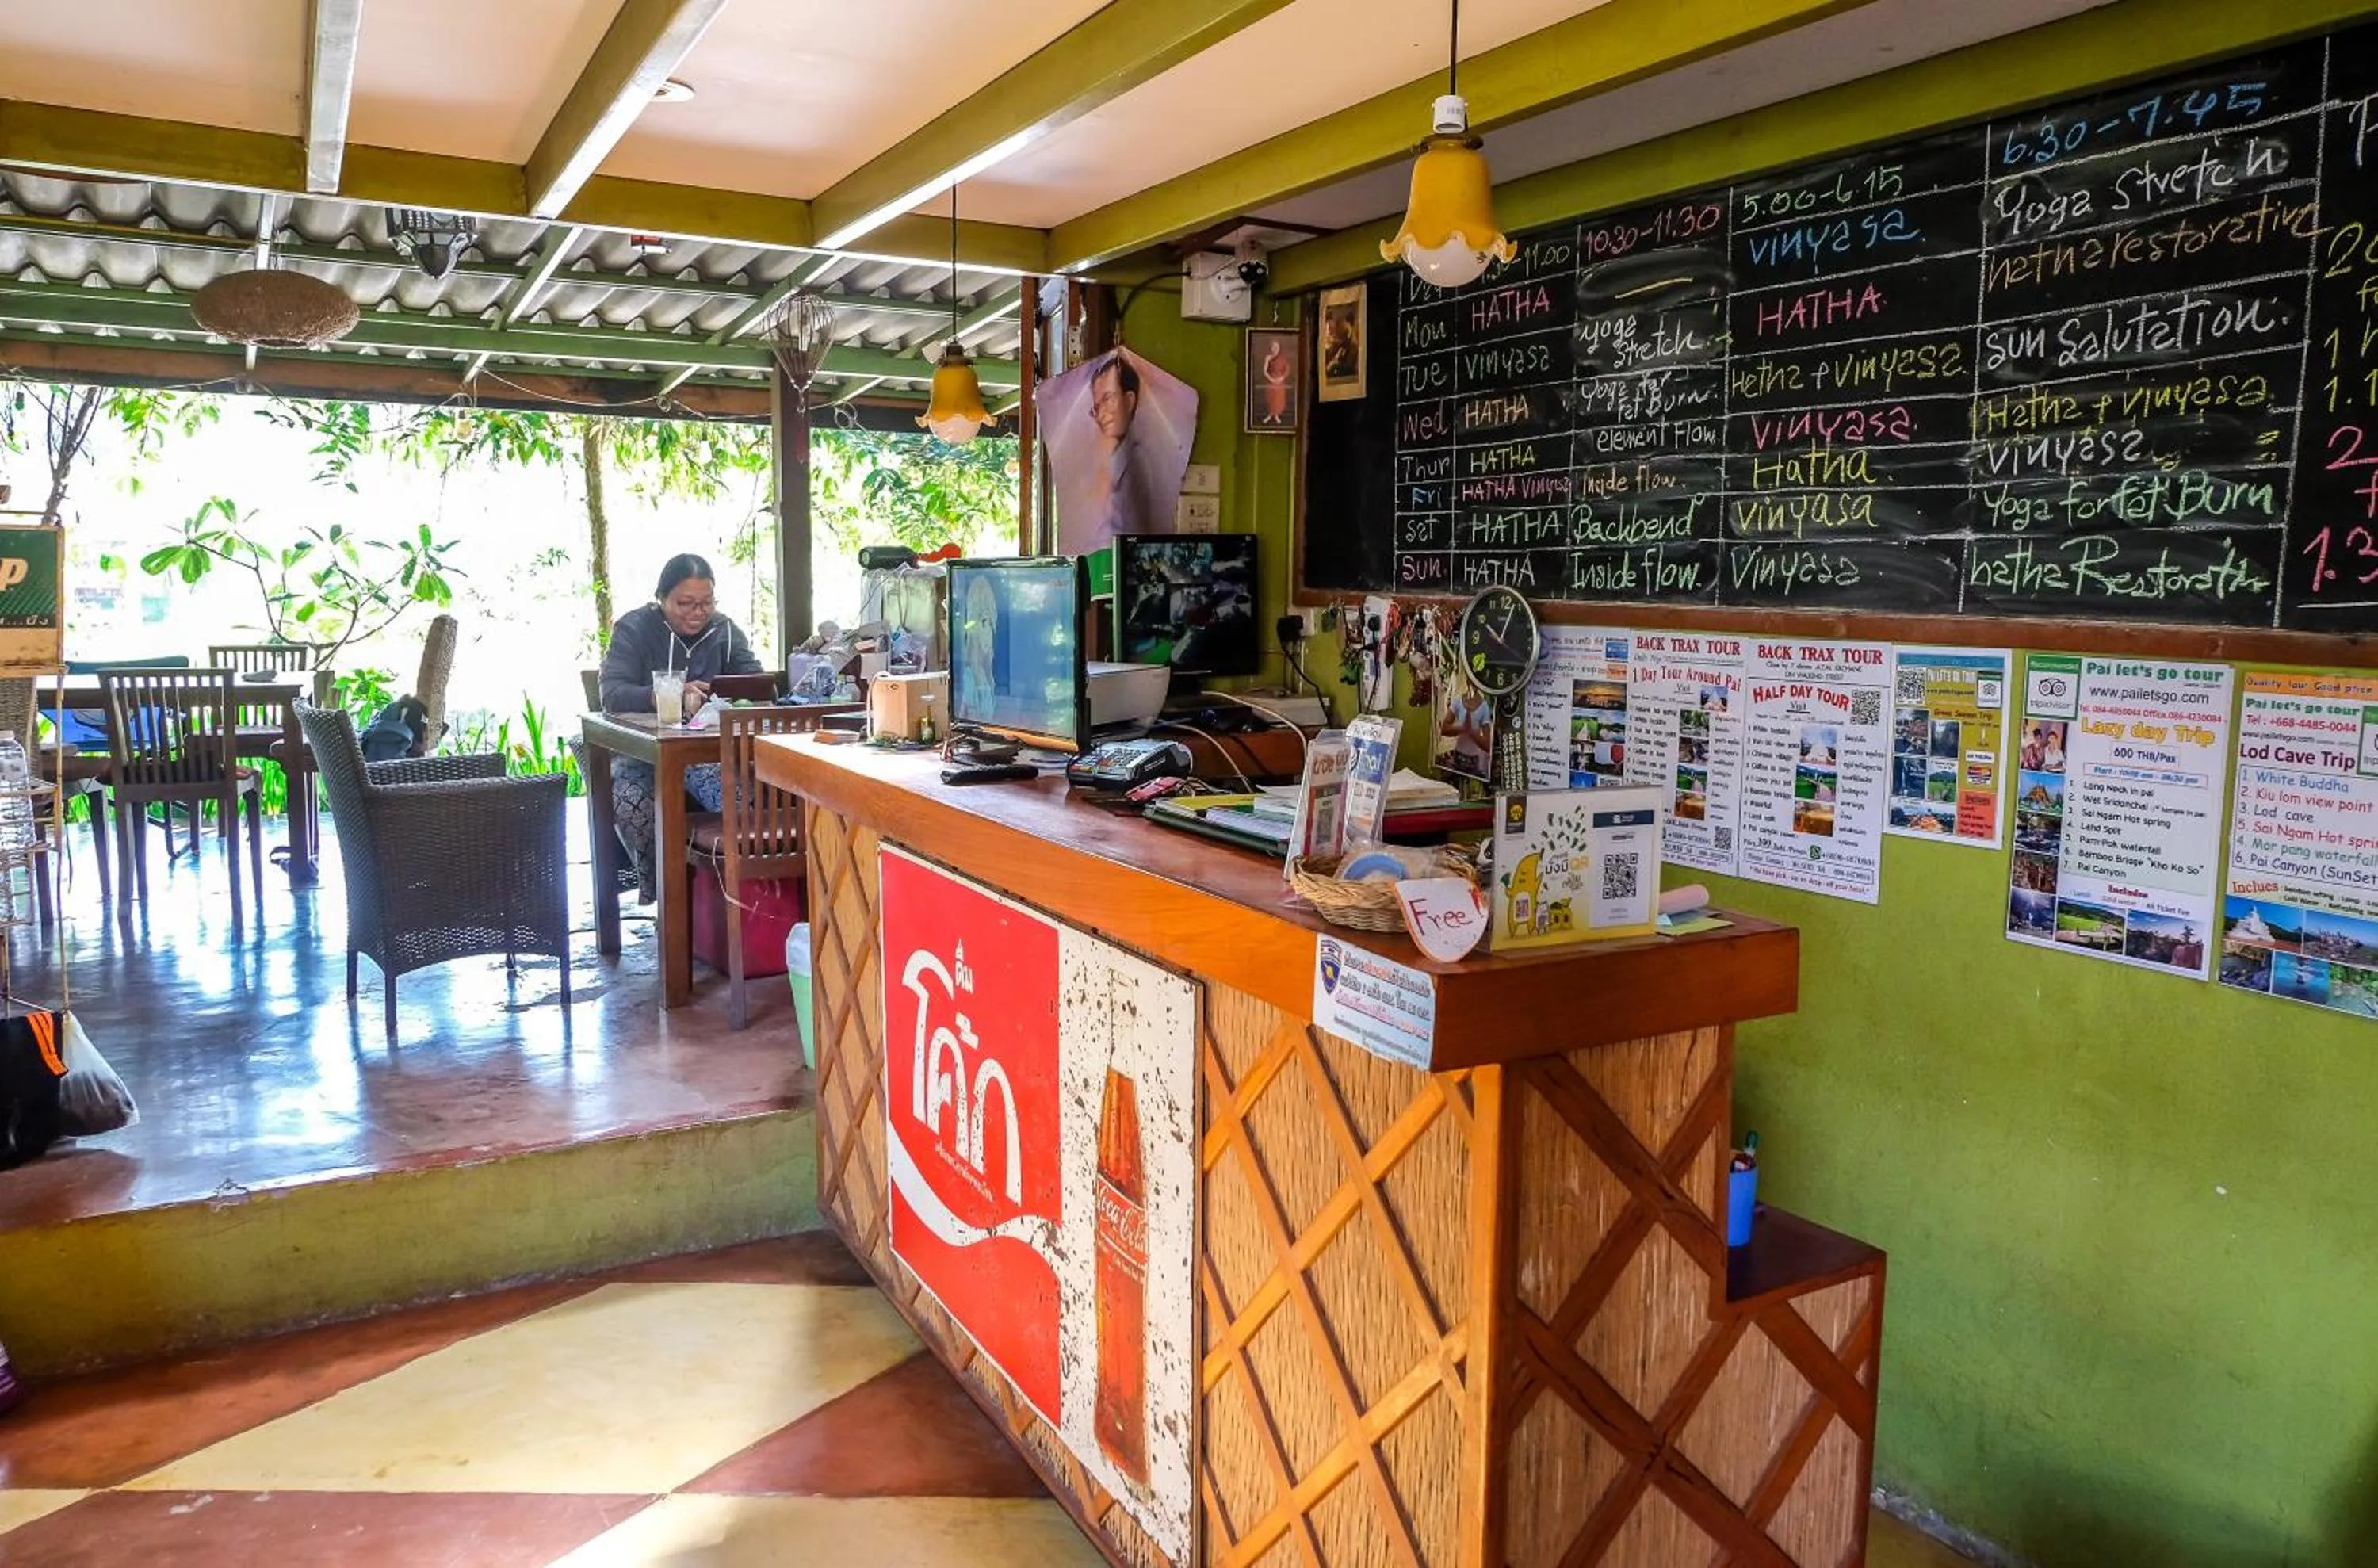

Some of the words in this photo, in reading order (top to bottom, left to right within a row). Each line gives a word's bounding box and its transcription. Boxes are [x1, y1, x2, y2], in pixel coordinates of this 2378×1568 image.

[1586, 205, 1721, 254] 10.30-11.30
[1405, 318, 1447, 350] Mon
[1471, 285, 1550, 332] HATHA
[1402, 404, 1450, 442] Wed
[1463, 393, 1531, 428] HATHA
[1401, 456, 1451, 480] Thur
[1470, 445, 1537, 474] HATHA
[1411, 486, 1443, 510] Fri
[1462, 479, 1516, 503] HATHA
[1470, 510, 1562, 545] HATHA
[1463, 556, 1537, 587] HATHA
[1636, 636, 1665, 651] BACK
[1671, 637, 1700, 653] TRAX
[1706, 640, 1741, 656] TOUR
[1757, 644, 1793, 660] BACK
[1799, 646, 1835, 662] TRAX
[1842, 648, 1883, 665] TOUR
[1686, 667, 1721, 686] Around
[1726, 674, 1741, 692] Pai
[2086, 662, 2112, 675] Pai
[2116, 663, 2153, 678] let's
[2157, 668, 2178, 681] go
[2184, 667, 2225, 683] tour
[1753, 685, 1787, 704] HALF
[1791, 684, 1814, 699] DAY
[1816, 687, 1850, 713] TOUR
[2246, 698, 2267, 709] Pai
[2271, 698, 2301, 712] let's
[2304, 704, 2323, 714] go
[2327, 705, 2361, 716] tour
[2081, 716, 2126, 740] Lazy
[2130, 721, 2169, 744] day
[2173, 723, 2216, 748] Trip
[2113, 748, 2134, 759] 600
[2240, 743, 2269, 760] Lod
[2274, 746, 2315, 764] Cave
[2321, 751, 2356, 771] Trip
[2255, 771, 2296, 786] White
[2300, 775, 2349, 793] Buddha
[2254, 804, 2277, 818] Lod
[2285, 811, 2315, 824] cave
[2306, 794, 2334, 808] view
[2338, 798, 2374, 813] point
[2253, 821, 2273, 834] Sai
[2277, 824, 2314, 842] Ngam
[2319, 830, 2343, 844] Hot
[2250, 853, 2268, 867] Pai
[2273, 858, 2317, 876] Canyon
